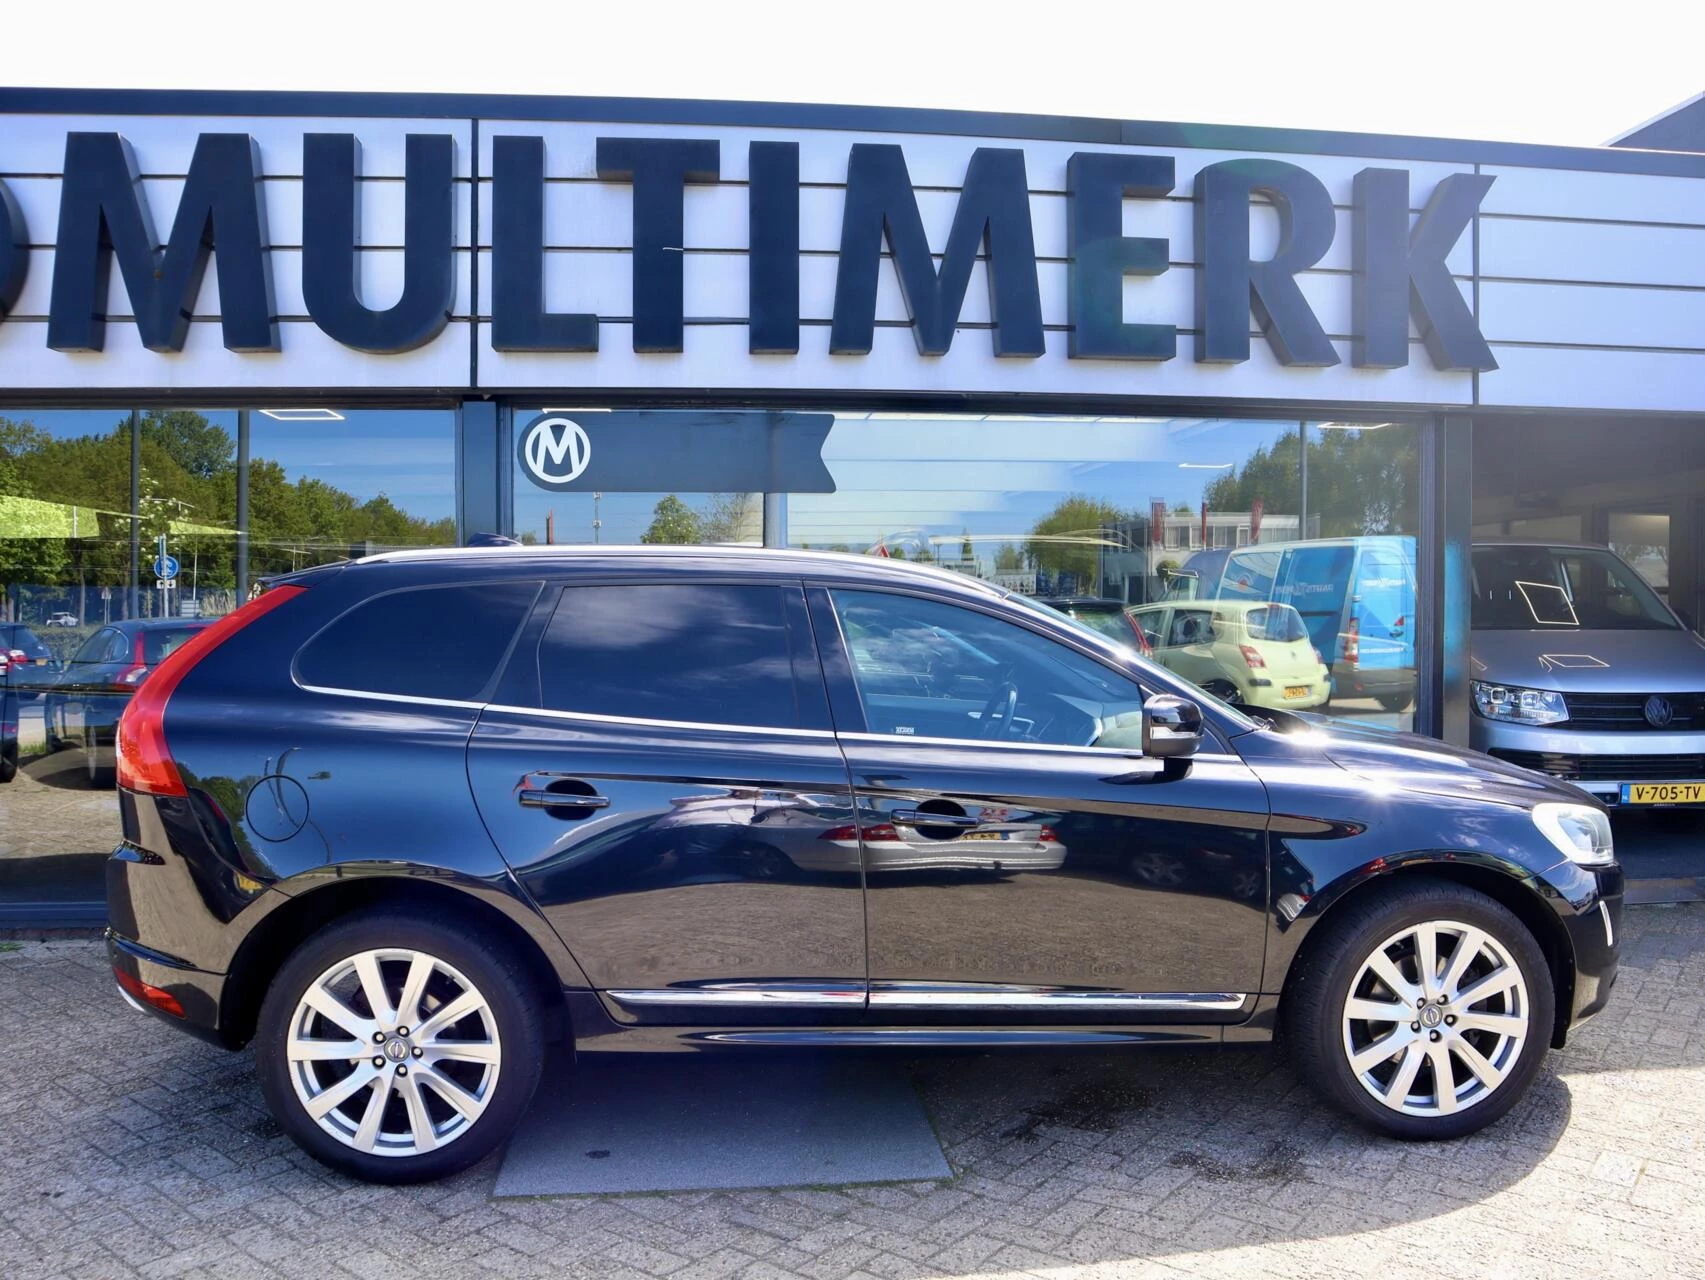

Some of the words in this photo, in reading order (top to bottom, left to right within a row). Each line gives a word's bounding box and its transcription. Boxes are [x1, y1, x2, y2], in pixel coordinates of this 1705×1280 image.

[0, 132, 1498, 372] MULTIMERK
[525, 418, 591, 484] M
[1636, 786, 1701, 801] V-705-TV
